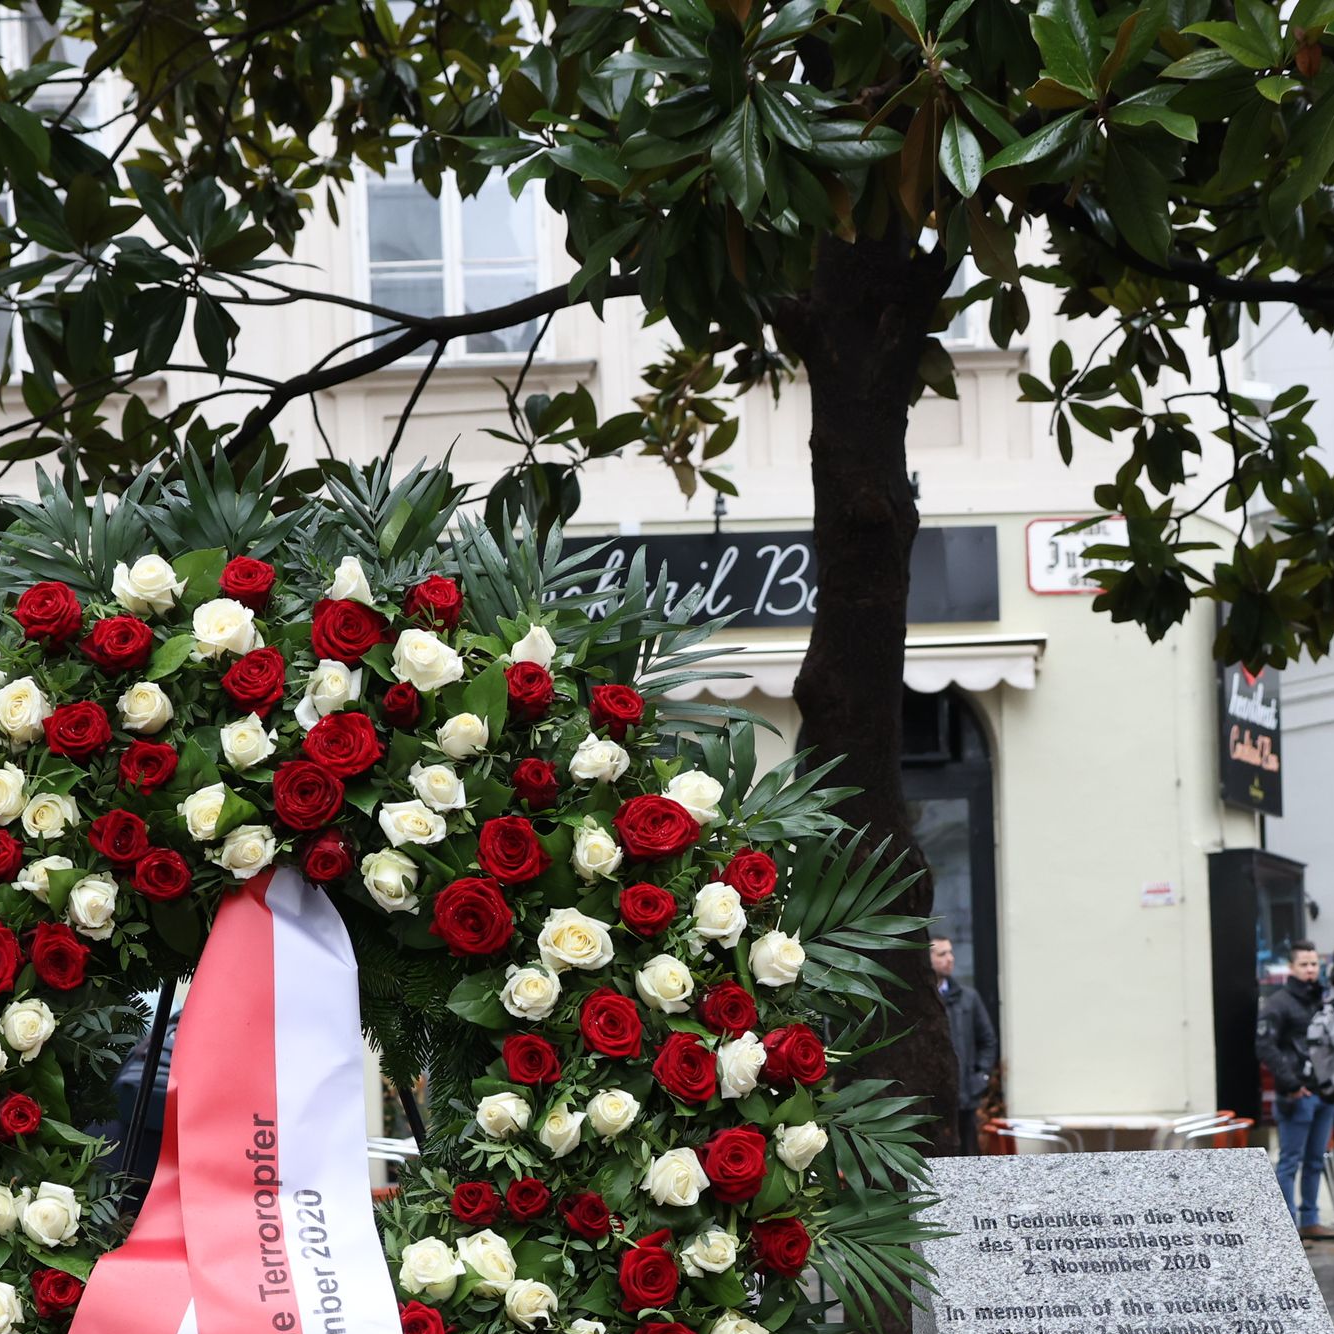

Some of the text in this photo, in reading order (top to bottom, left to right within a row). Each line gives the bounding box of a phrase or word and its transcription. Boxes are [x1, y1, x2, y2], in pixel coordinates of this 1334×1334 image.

[245, 1112, 291, 1303] Terroropfer
[972, 1207, 1235, 1230] Im Gedenken an die Opfer
[293, 1189, 332, 1260] 2020
[978, 1232, 1244, 1252] des Terroranschlages vom
[1051, 1255, 1151, 1275] November
[1160, 1253, 1212, 1271] 2020
[946, 1293, 1311, 1321] In memoriam of the victims of the
